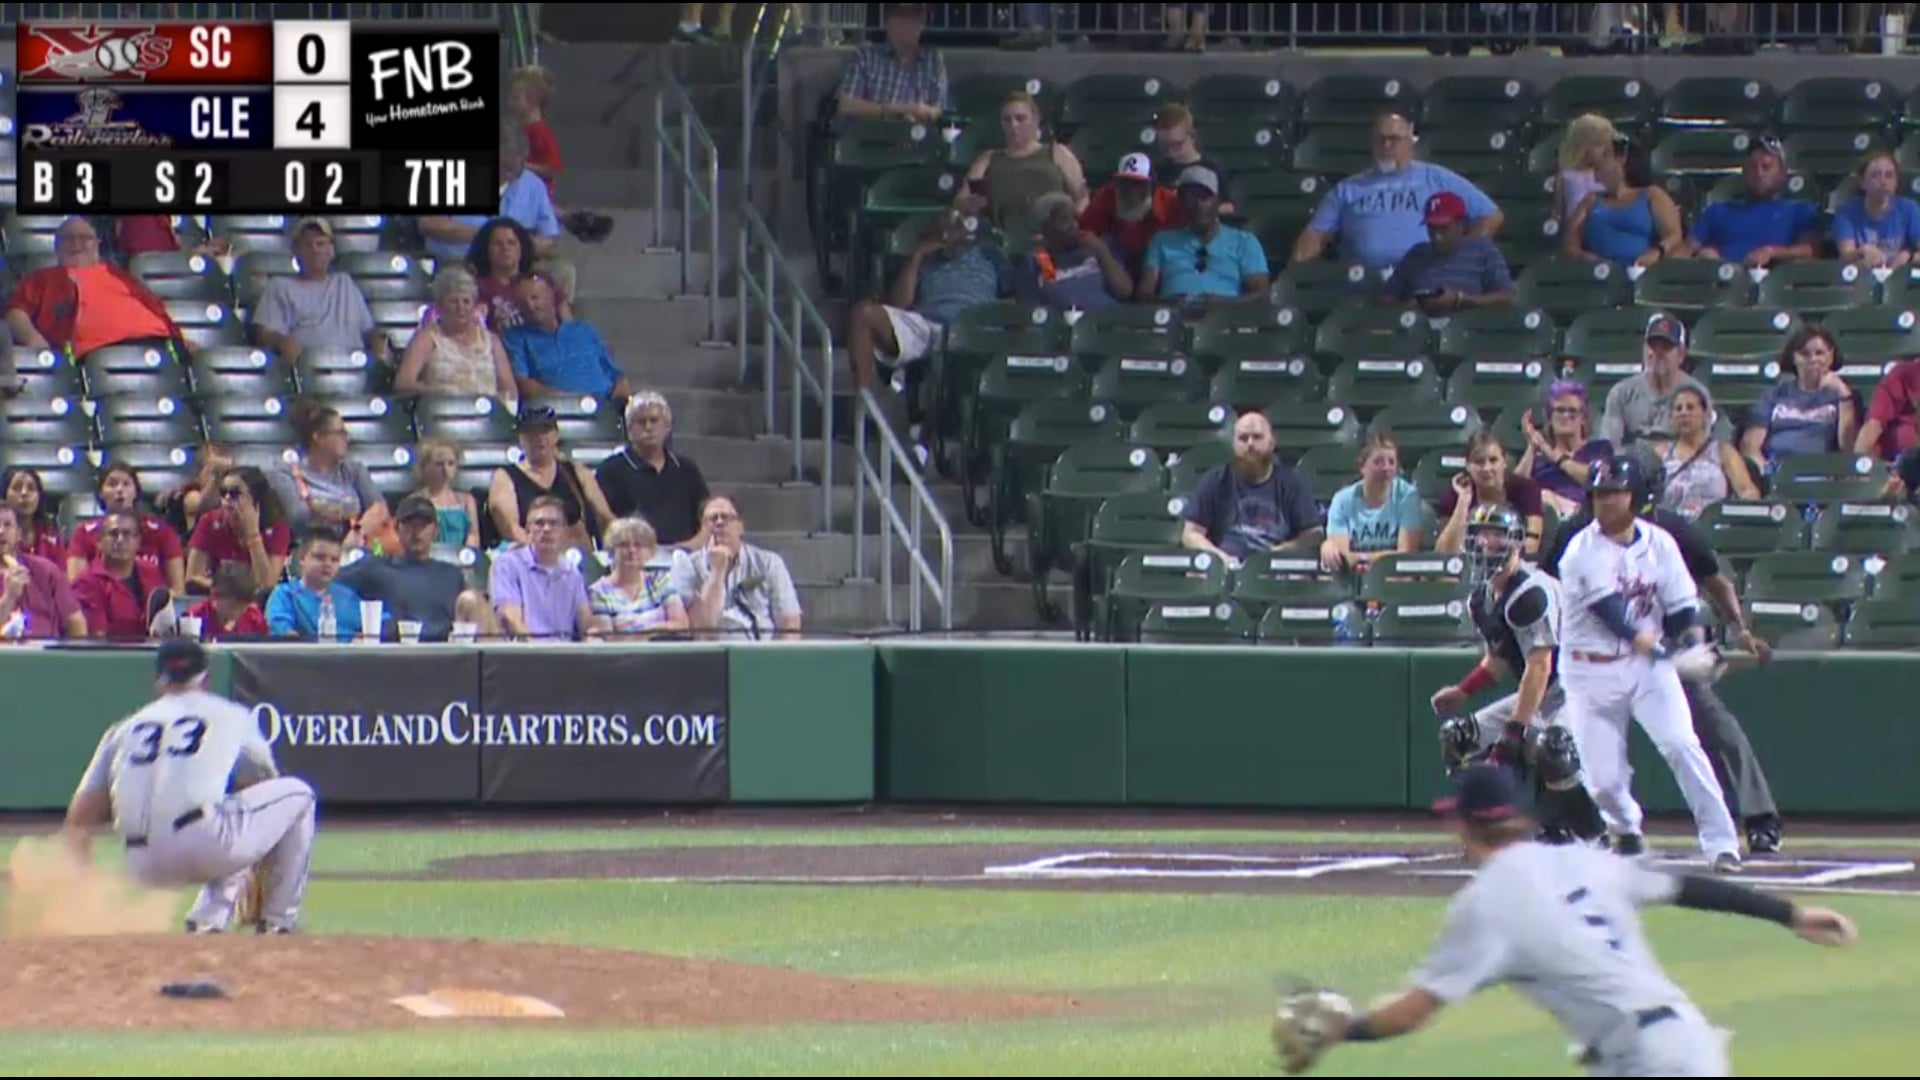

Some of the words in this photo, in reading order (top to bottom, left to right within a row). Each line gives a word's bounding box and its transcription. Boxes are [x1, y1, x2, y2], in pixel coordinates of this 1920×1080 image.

[1360, 190, 1419, 212] PAPA
[130, 716, 206, 766] 33
[253, 702, 716, 747] OVERLANDCHARTERS.COM
